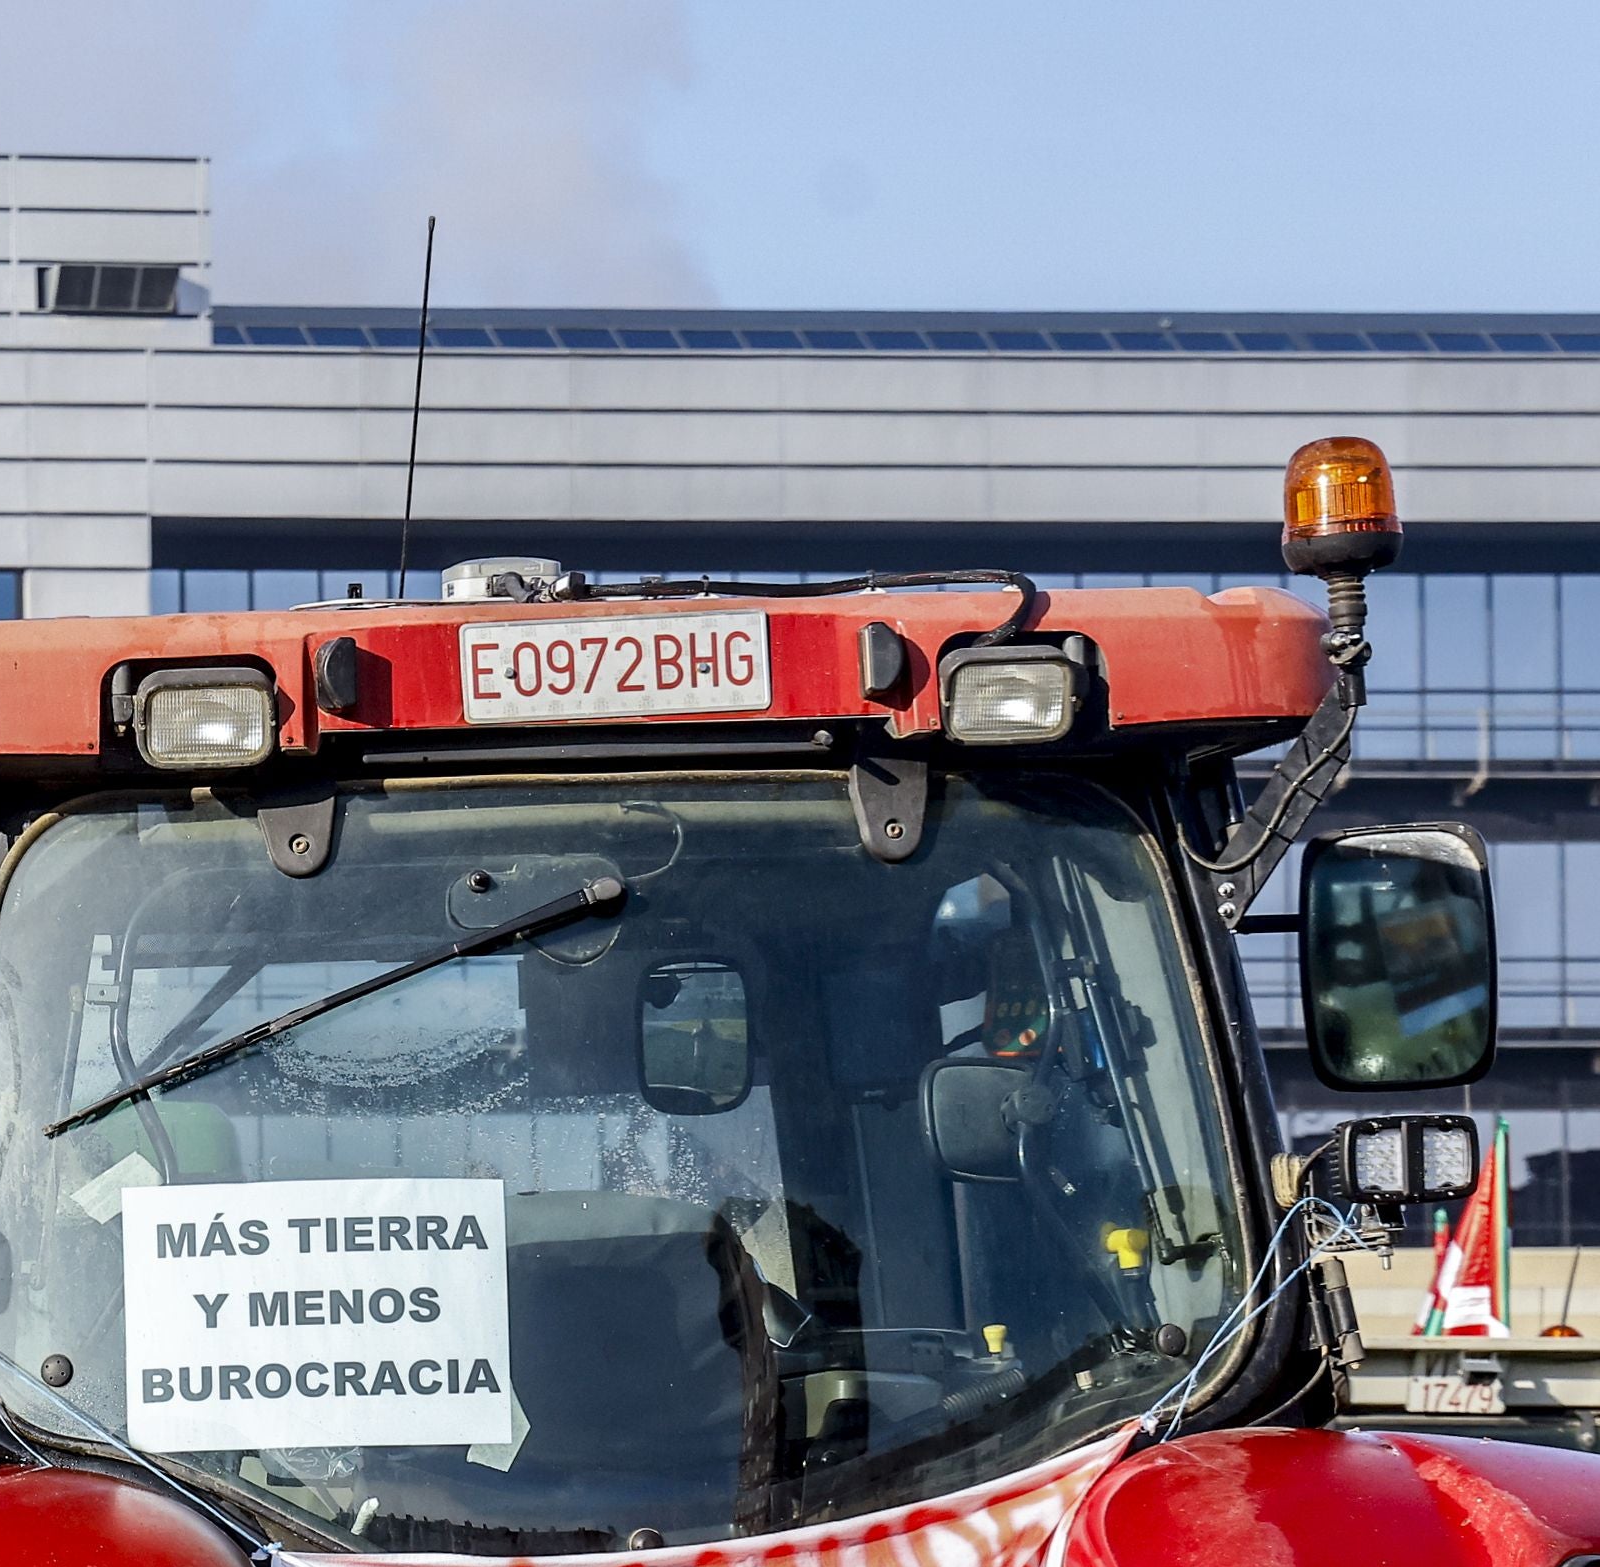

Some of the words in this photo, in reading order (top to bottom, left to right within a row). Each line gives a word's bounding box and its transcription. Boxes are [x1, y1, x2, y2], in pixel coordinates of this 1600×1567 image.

[156, 1212, 270, 1259] MÁS
[287, 1215, 489, 1254] TIERRA
[193, 1293, 230, 1329] Y
[248, 1287, 441, 1327] MENOS
[141, 1359, 502, 1404] BUROCRACIA
